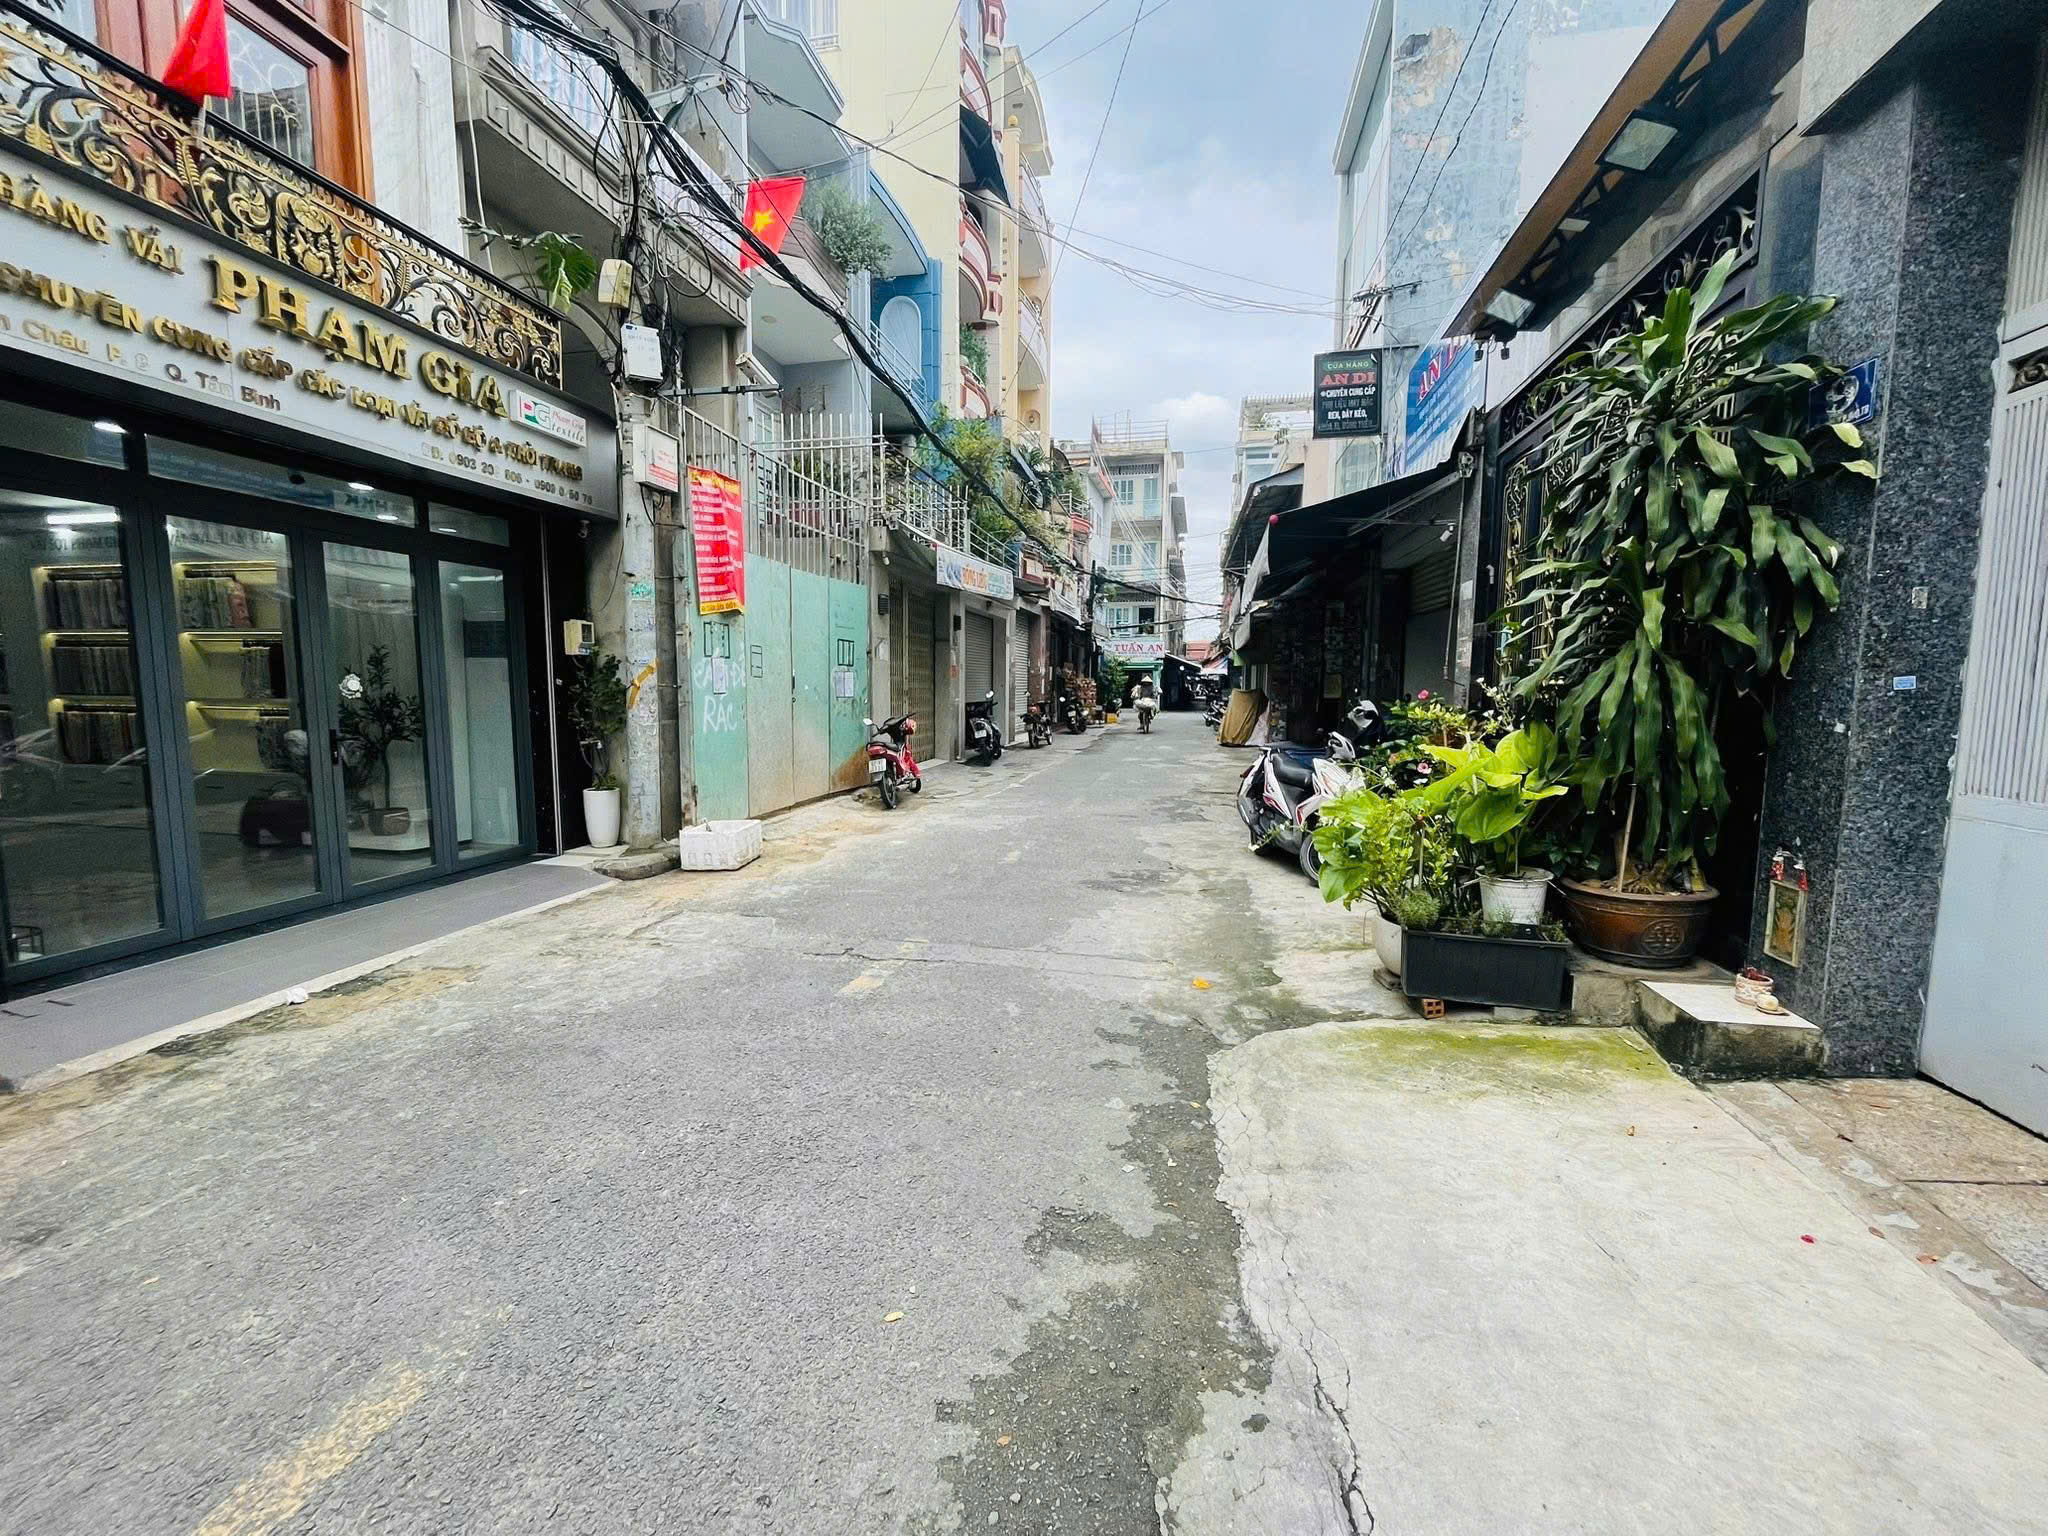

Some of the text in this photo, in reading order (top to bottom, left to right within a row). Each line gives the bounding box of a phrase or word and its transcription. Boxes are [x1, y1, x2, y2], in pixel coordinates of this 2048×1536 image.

[124, 224, 184, 275] VẢI
[207, 254, 509, 419] PHẠM GIA
[152, 315, 234, 364] CUNG
[242, 346, 294, 382] CẤP
[302, 368, 347, 401] CÁC
[350, 386, 400, 420] LOẠI
[1320, 373, 1350, 386] AN
[1364, 383, 1376, 396] CẤP
[1148, 643, 1163, 652] AN
[703, 693, 737, 734] RÁC
